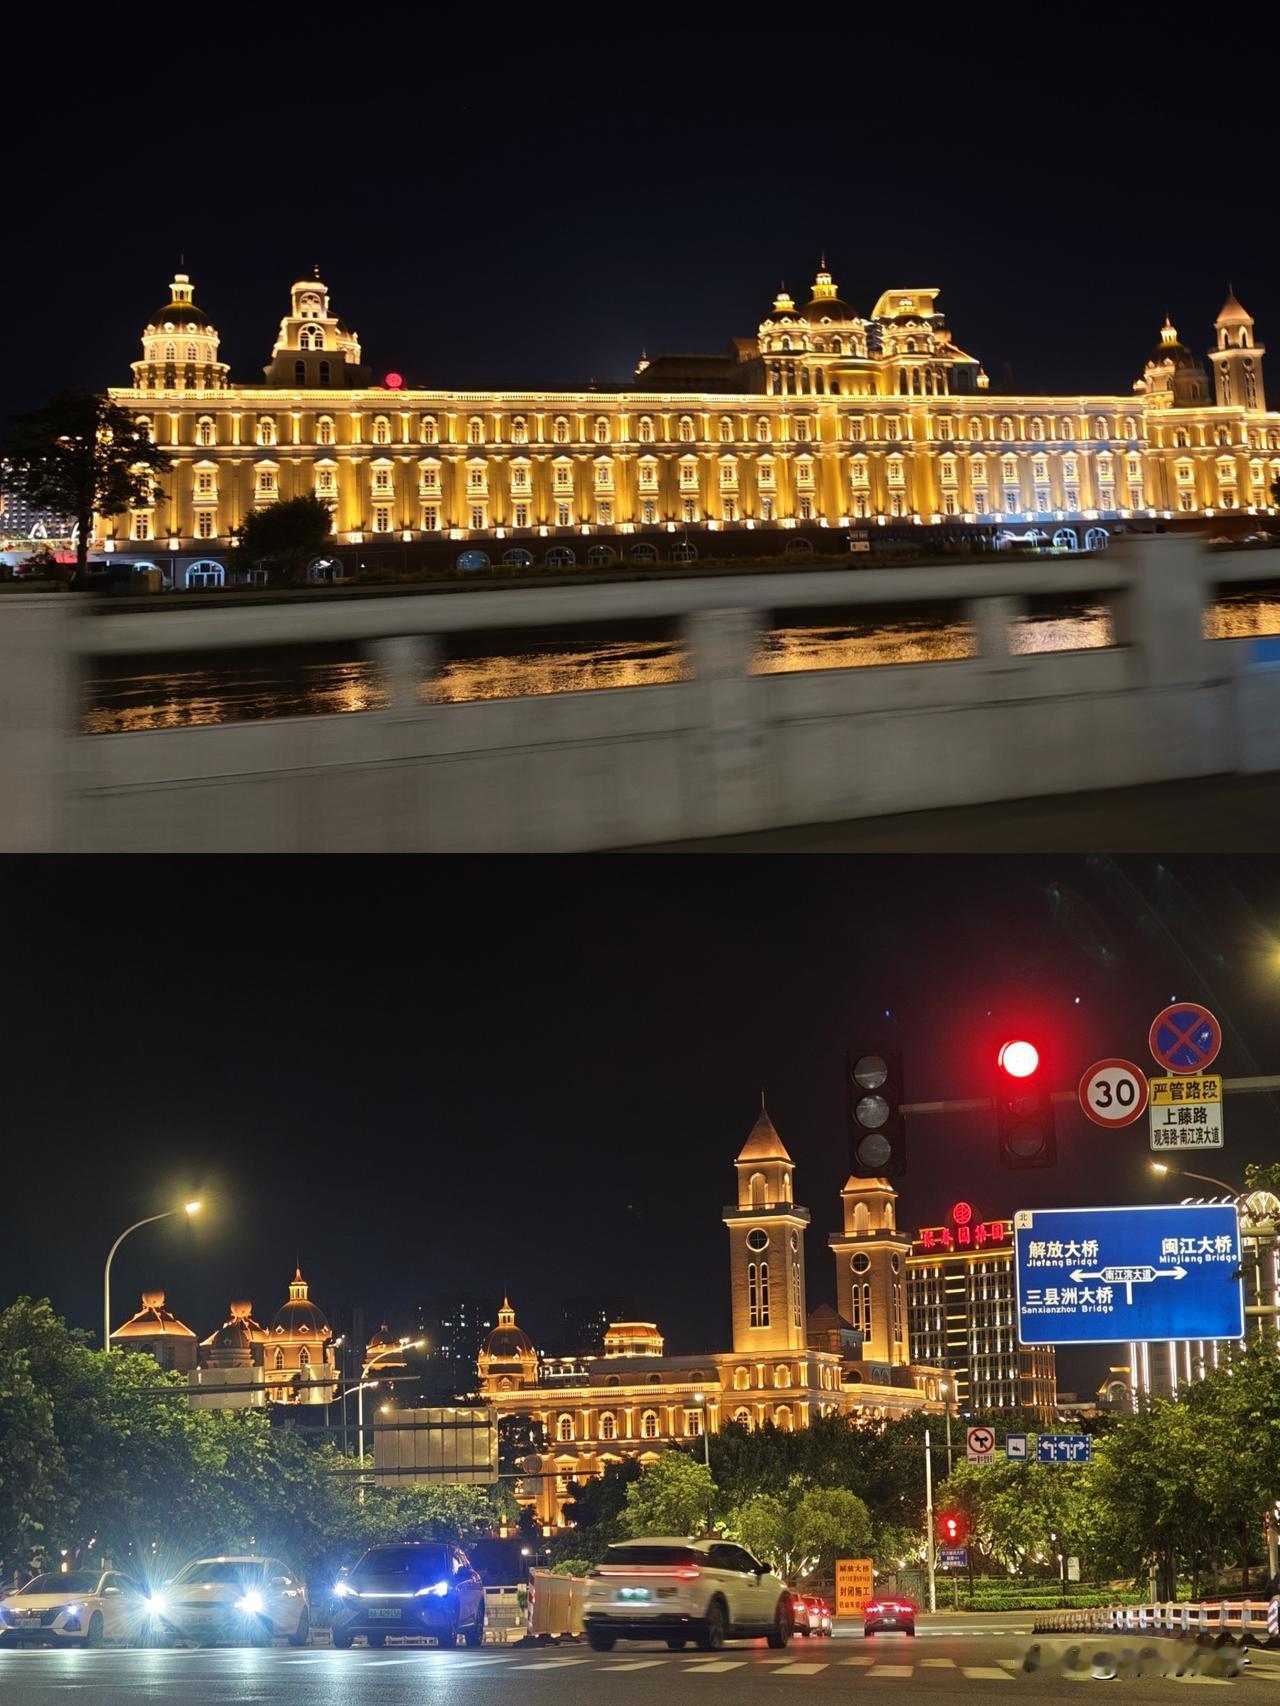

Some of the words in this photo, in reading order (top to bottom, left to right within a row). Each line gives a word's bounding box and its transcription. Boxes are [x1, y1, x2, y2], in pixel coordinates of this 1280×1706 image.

[1095, 1079, 1135, 1108] 30
[1153, 1081, 1218, 1101] 严管路段
[1163, 1106, 1208, 1125] 上藤路
[1019, 1213, 1028, 1221] 北
[1028, 1240, 1099, 1258] 解放大桥
[1162, 1235, 1233, 1255] 闽江大桥
[1026, 1259, 1064, 1268] Jiefang
[1066, 1258, 1098, 1267] Bridge
[1159, 1255, 1203, 1264] Minjiang
[1205, 1254, 1237, 1263] Bridge
[1105, 1269, 1152, 1280] 南江滨大道
[1026, 1286, 1114, 1305] 三县洲大桥
[1021, 1306, 1077, 1314] Sanxianzhou
[1081, 1305, 1114, 1314] Bridge
[840, 1586, 871, 1597] 封闭施工
